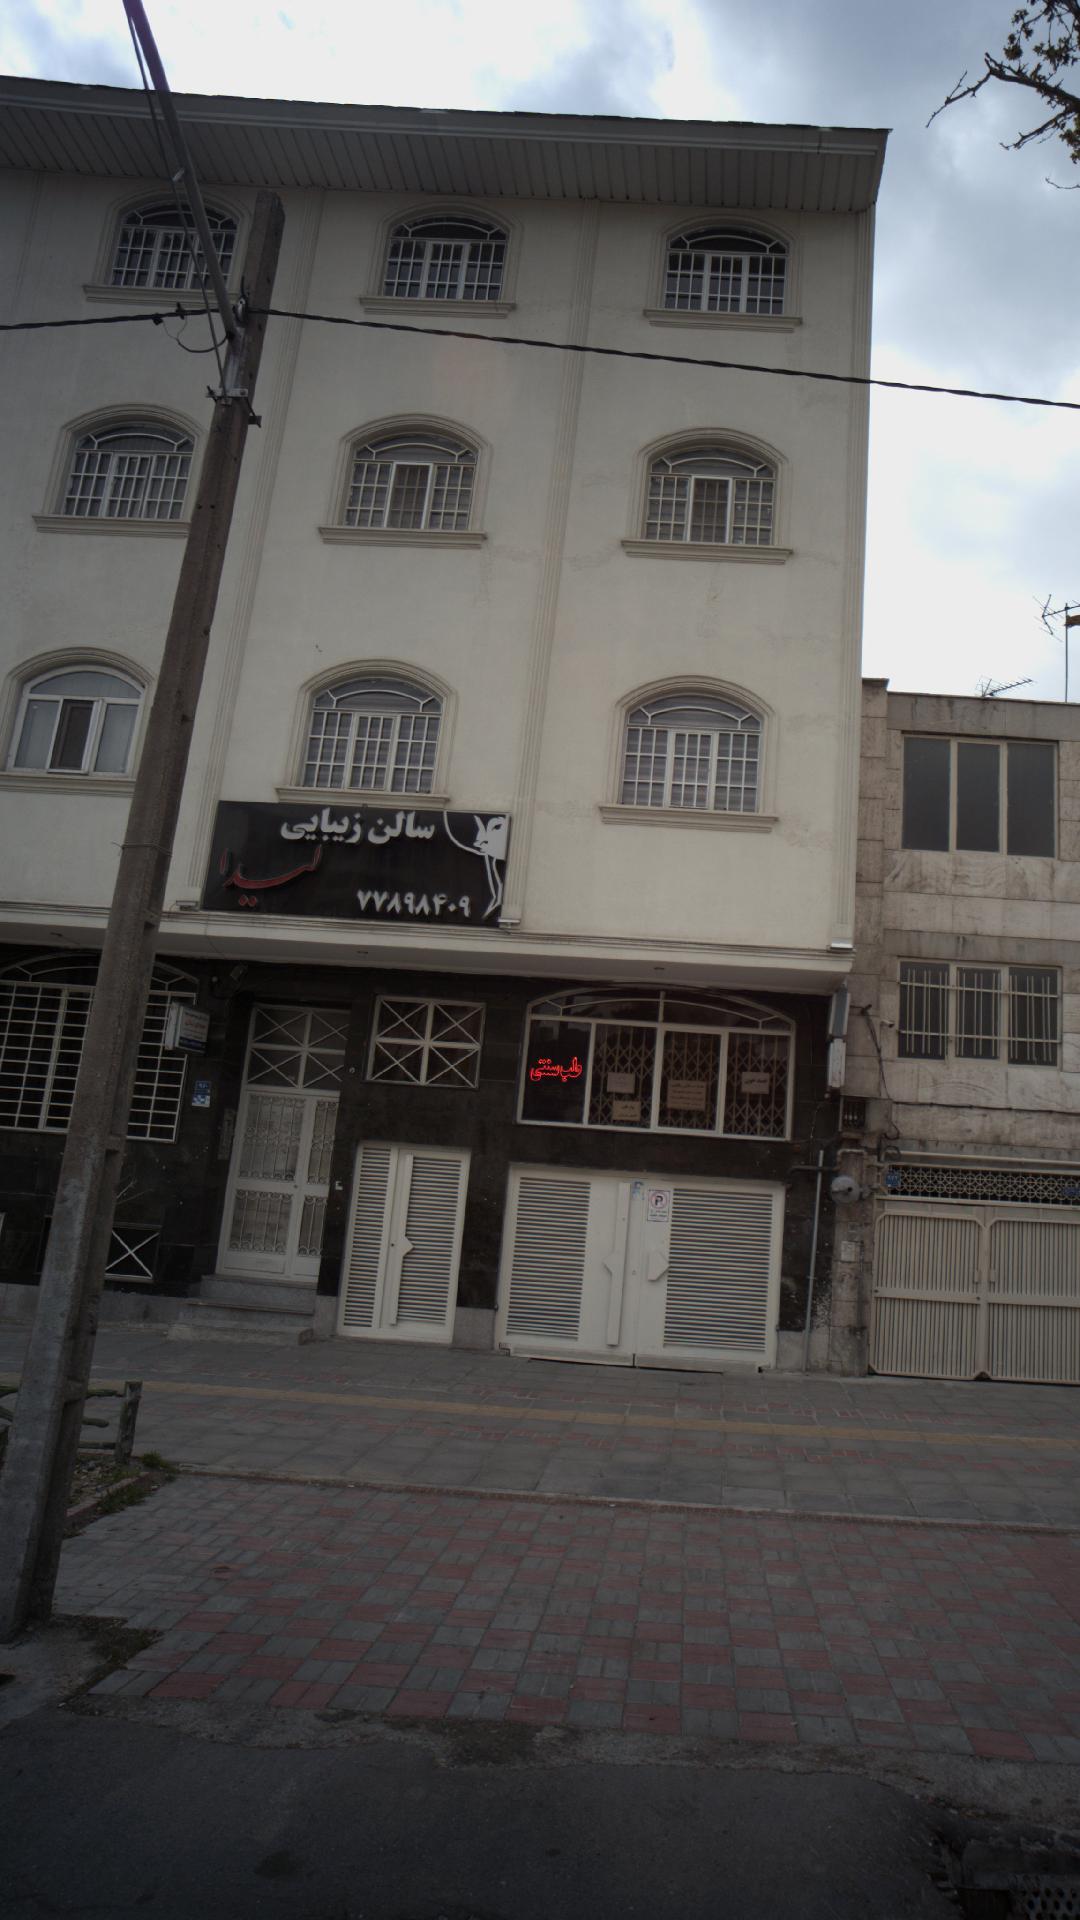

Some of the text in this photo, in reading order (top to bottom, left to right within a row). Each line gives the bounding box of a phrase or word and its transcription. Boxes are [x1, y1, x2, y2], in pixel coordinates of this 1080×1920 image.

[280, 807, 435, 844] سالن زیبایی
[356, 889, 471, 918] ۷۷۸۹۸۴۰۹
[529, 1058, 561, 1082] سنتی
[560, 1056, 583, 1082] طب
